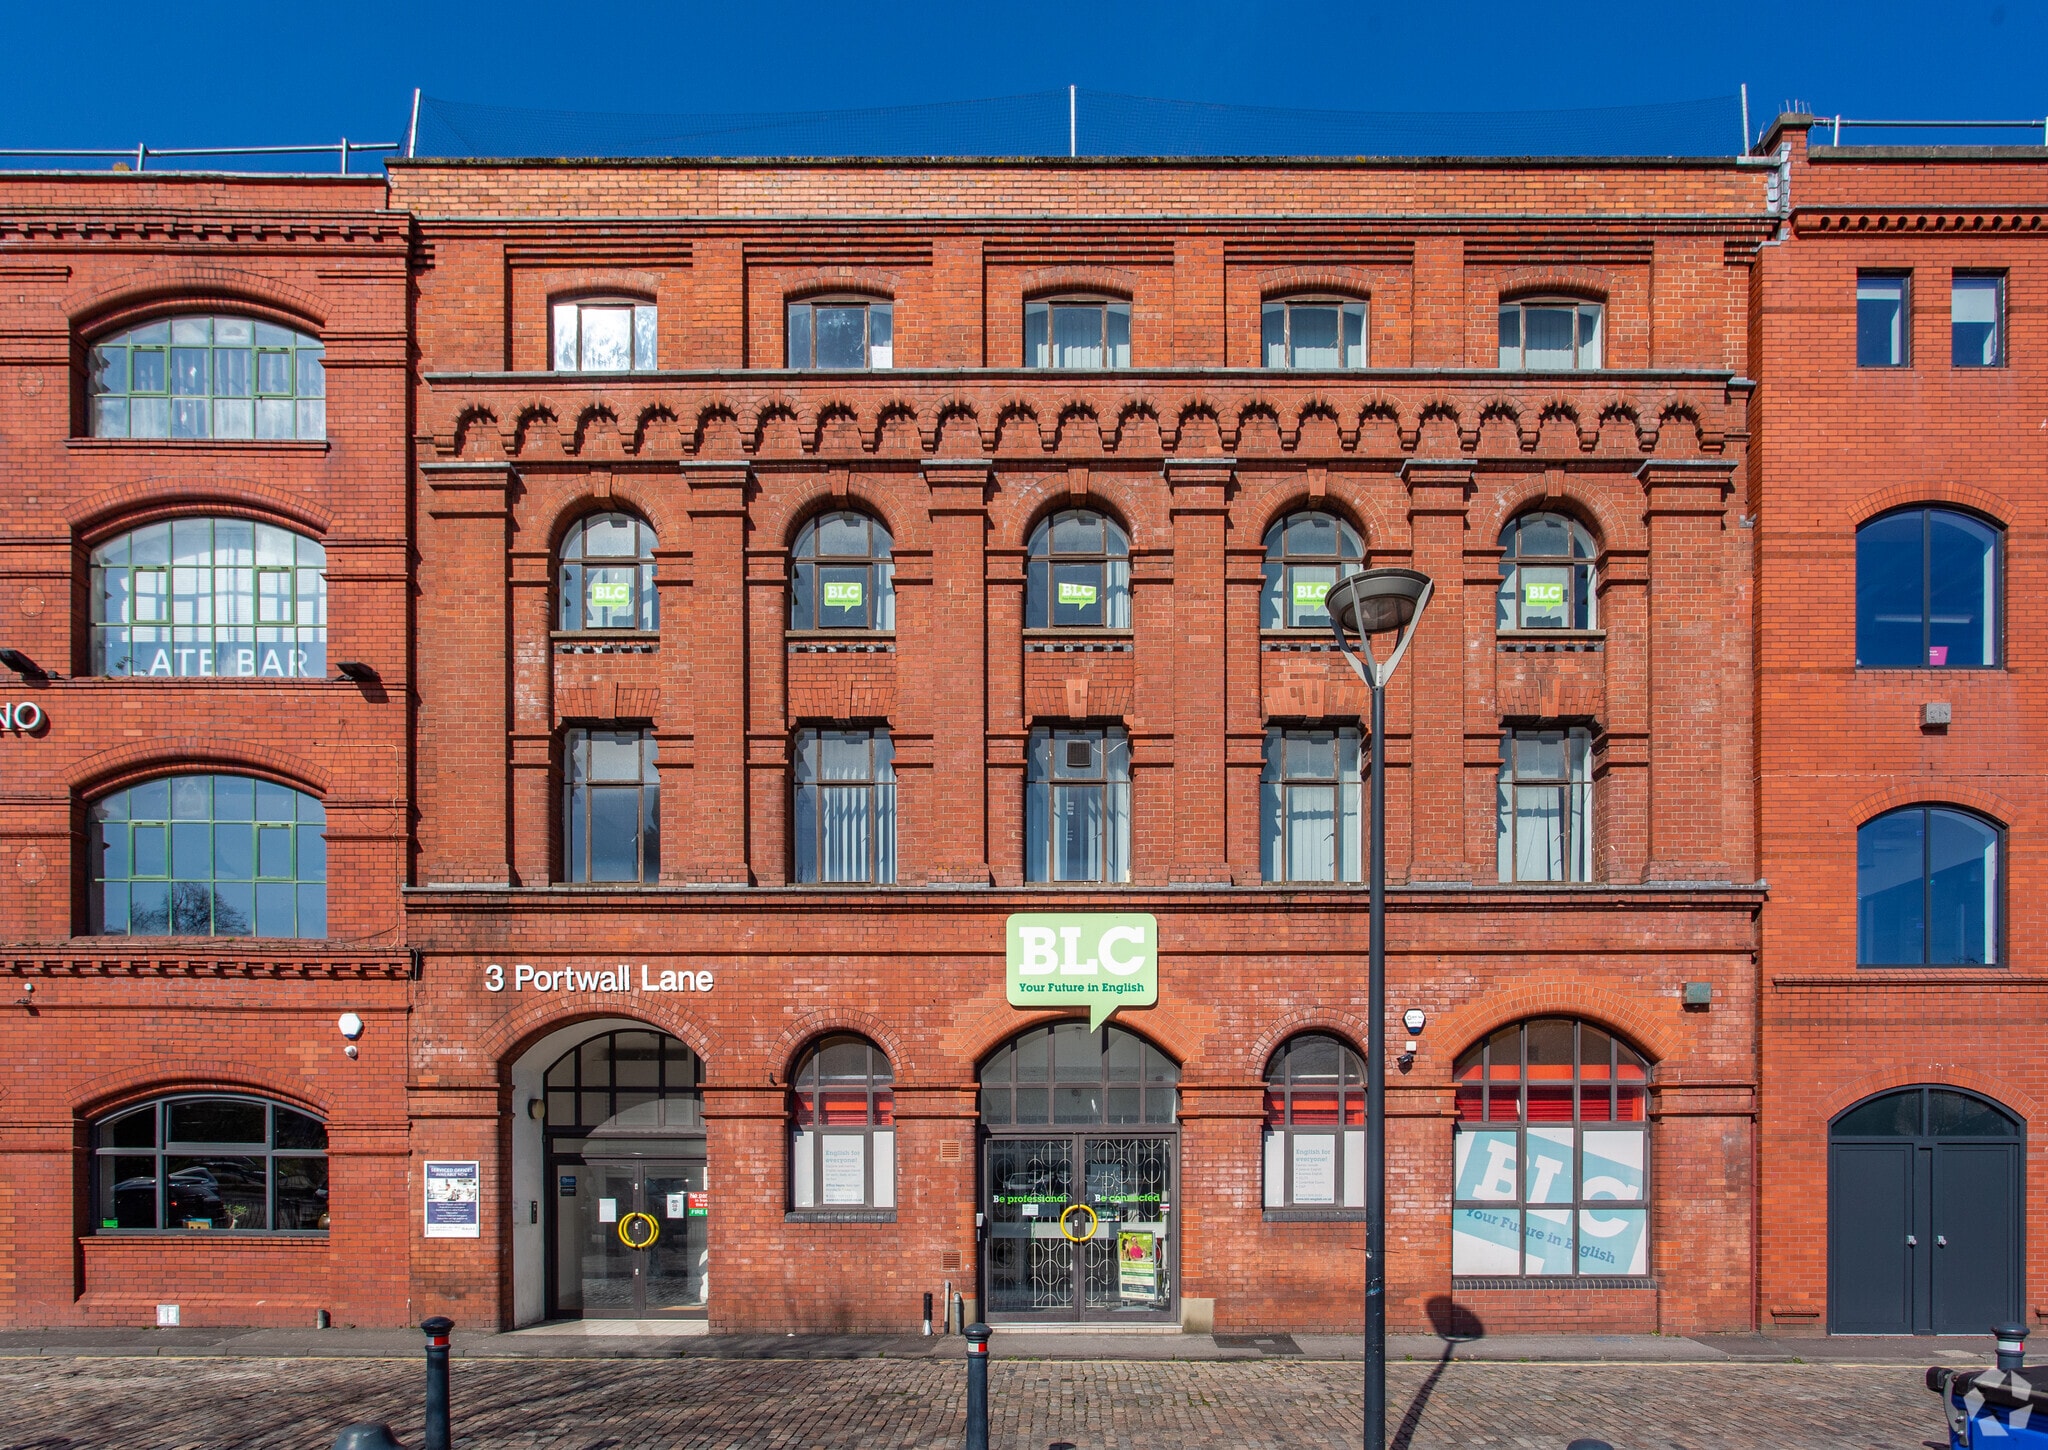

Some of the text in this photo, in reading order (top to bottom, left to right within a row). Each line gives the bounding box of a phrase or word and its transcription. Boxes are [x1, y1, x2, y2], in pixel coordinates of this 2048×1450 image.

[595, 586, 627, 599] BLC
[828, 585, 859, 599] BLC
[1062, 584, 1094, 597] BLC
[1296, 585, 1328, 598] BLC
[1529, 586, 1561, 599] BLC
[237, 648, 309, 677] BAR
[1018, 925, 1147, 976] BLC
[485, 964, 714, 992] 3 Portwall Lane
[1019, 982, 1145, 995] Your Future in English
[1472, 1138, 1639, 1239] BLC
[993, 1194, 1067, 1205] Be professional
[1095, 1193, 1160, 1202] Be connected
[1466, 1208, 1615, 1264] Your Fuure in Eglish
